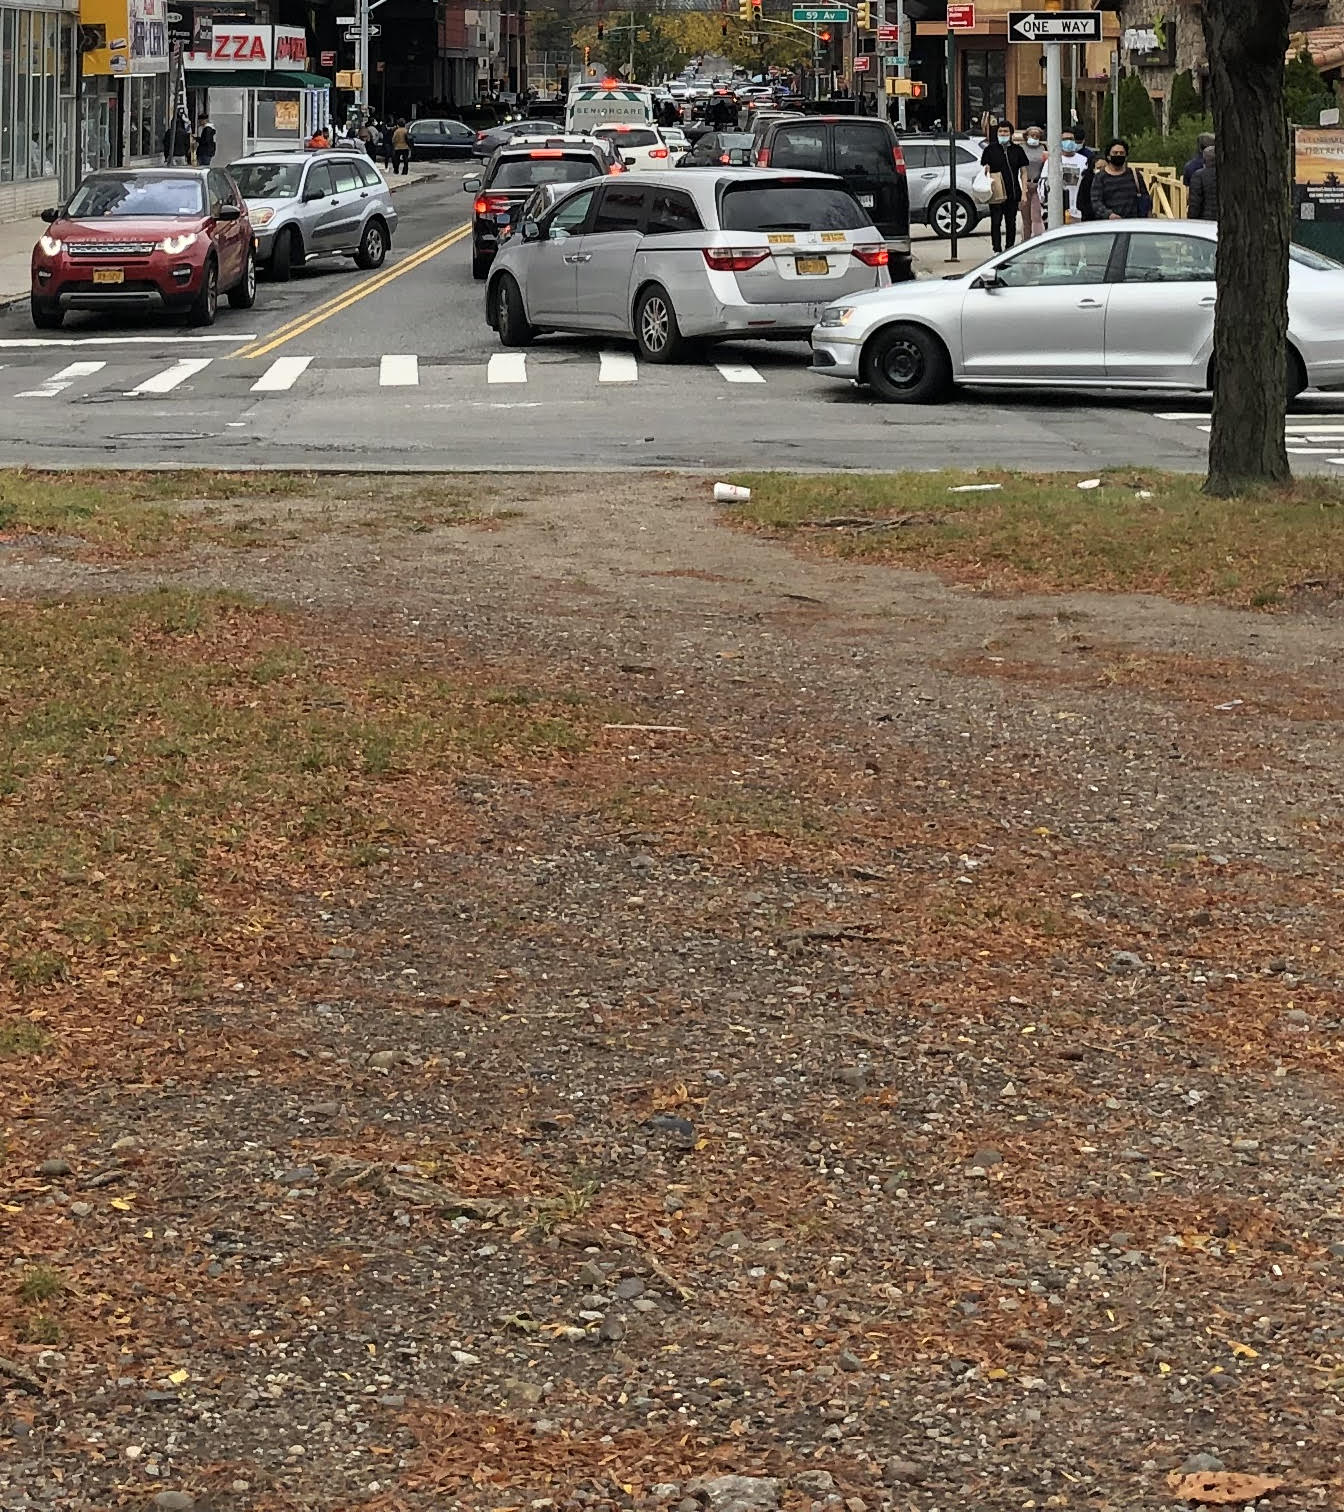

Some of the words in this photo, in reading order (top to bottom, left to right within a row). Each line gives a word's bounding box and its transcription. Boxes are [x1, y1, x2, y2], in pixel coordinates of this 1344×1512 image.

[806, 11, 818, 20] 59
[823, 11, 836, 20] Av
[1023, 21, 1050, 33] ONE
[1061, 21, 1089, 33] WAY
